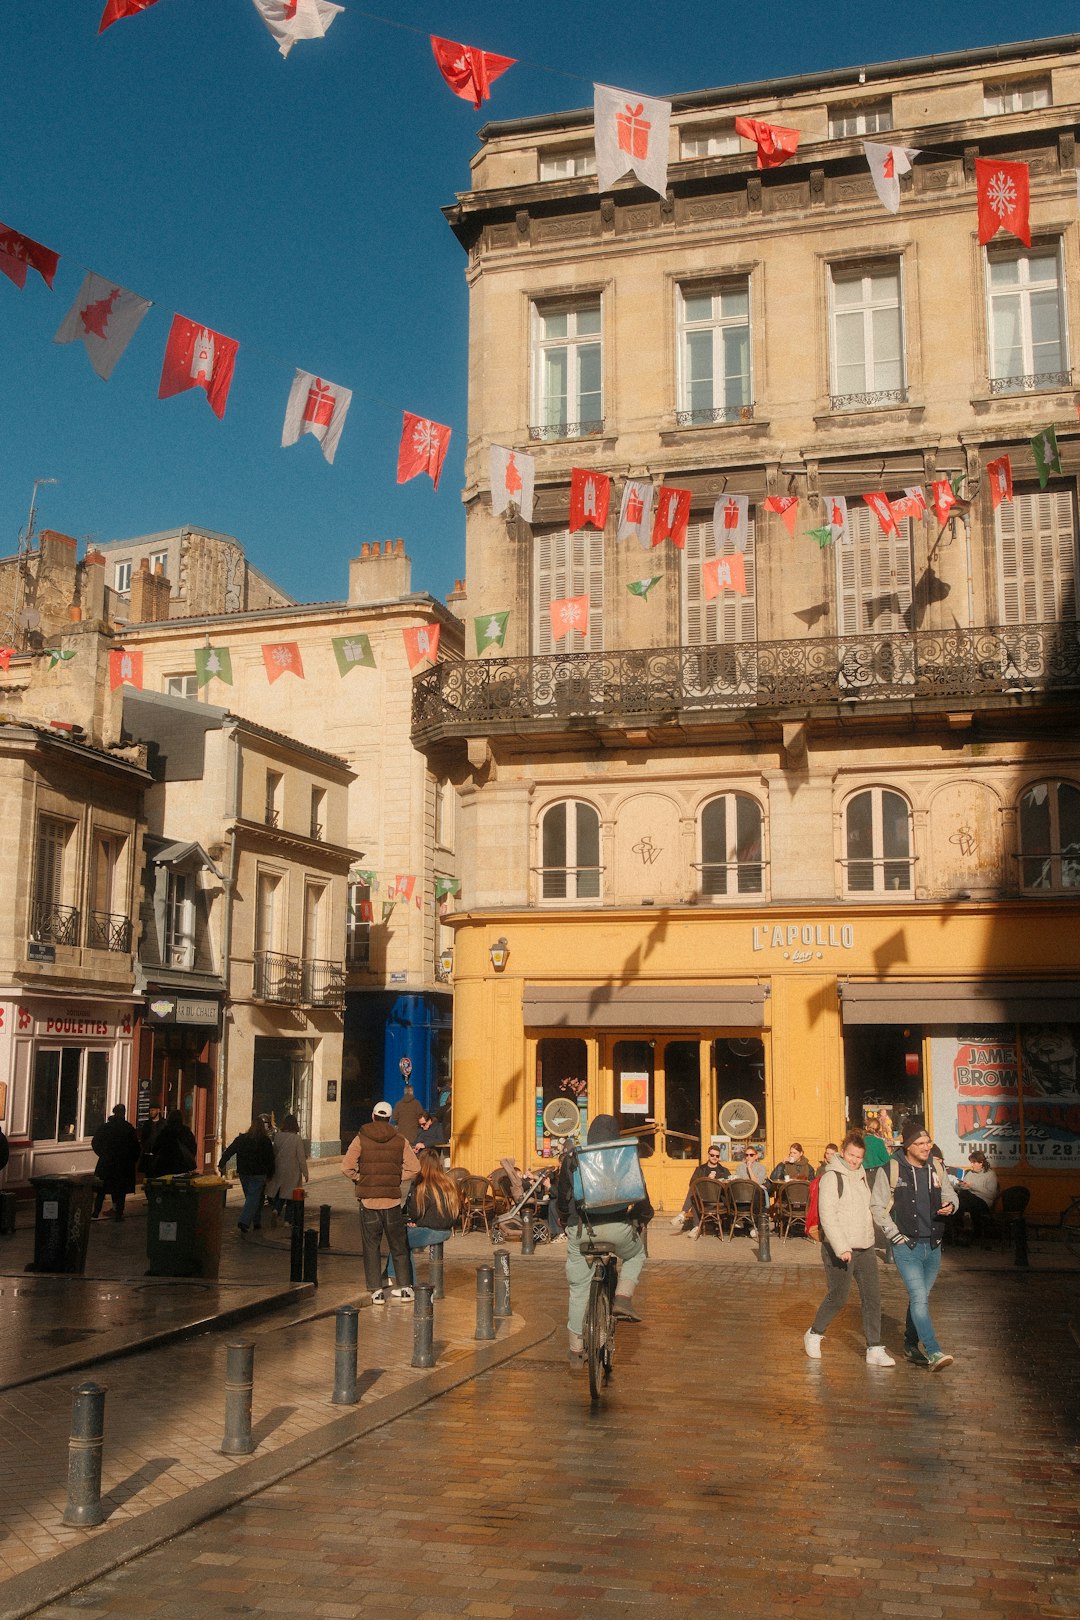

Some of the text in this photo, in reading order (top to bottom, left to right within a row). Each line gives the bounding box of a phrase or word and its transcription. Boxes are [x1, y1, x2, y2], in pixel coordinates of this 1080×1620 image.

[753, 924, 854, 952] L'APOLLO
[792, 950, 813, 964] bar
[46, 1017, 107, 1035] POULETTES
[957, 1067, 1031, 1087] BROWN
[959, 1143, 1002, 1155] THUR.
[1009, 1143, 1045, 1155] JULY
[1053, 1144, 1073, 1155] 28
